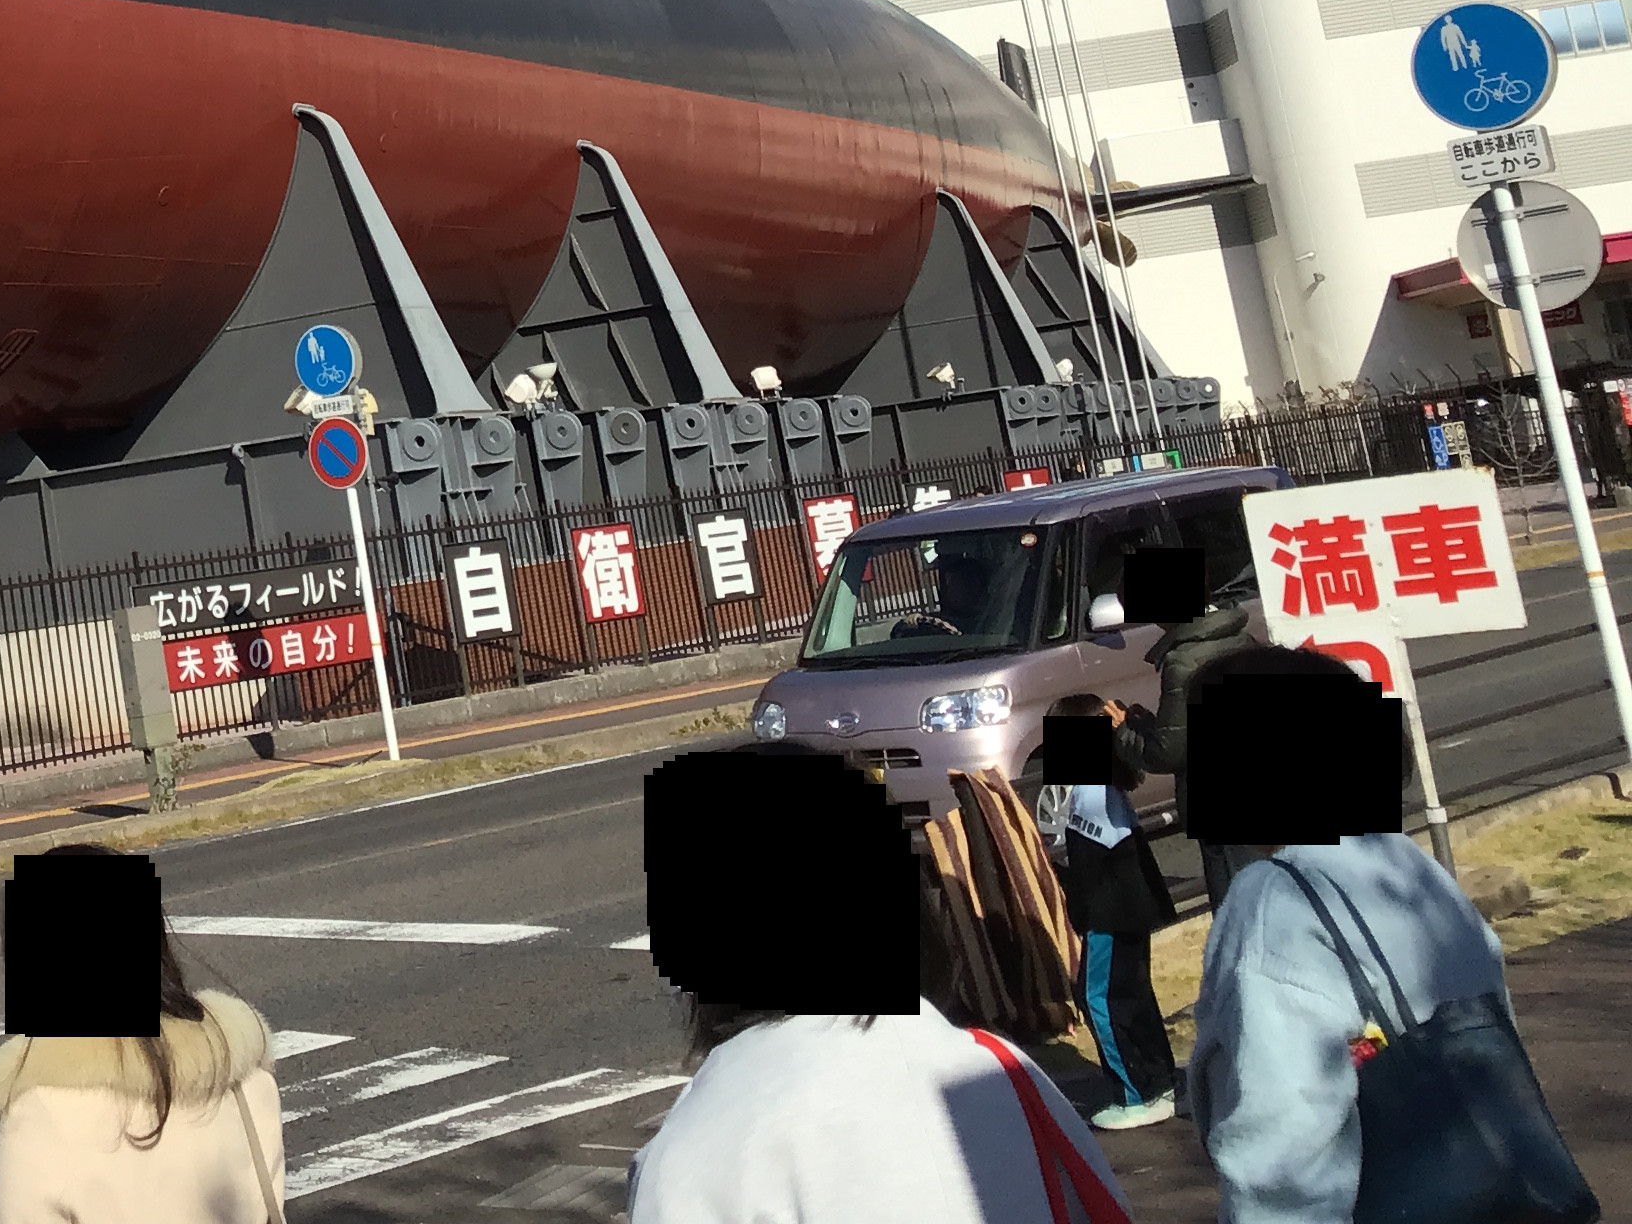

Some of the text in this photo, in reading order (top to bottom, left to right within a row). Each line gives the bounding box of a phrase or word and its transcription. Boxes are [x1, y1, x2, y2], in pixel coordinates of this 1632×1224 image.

[1453, 129, 1538, 161] 自転車歩道通行可
[1460, 152, 1542, 182] ここから
[1267, 504, 1498, 616] 満車
